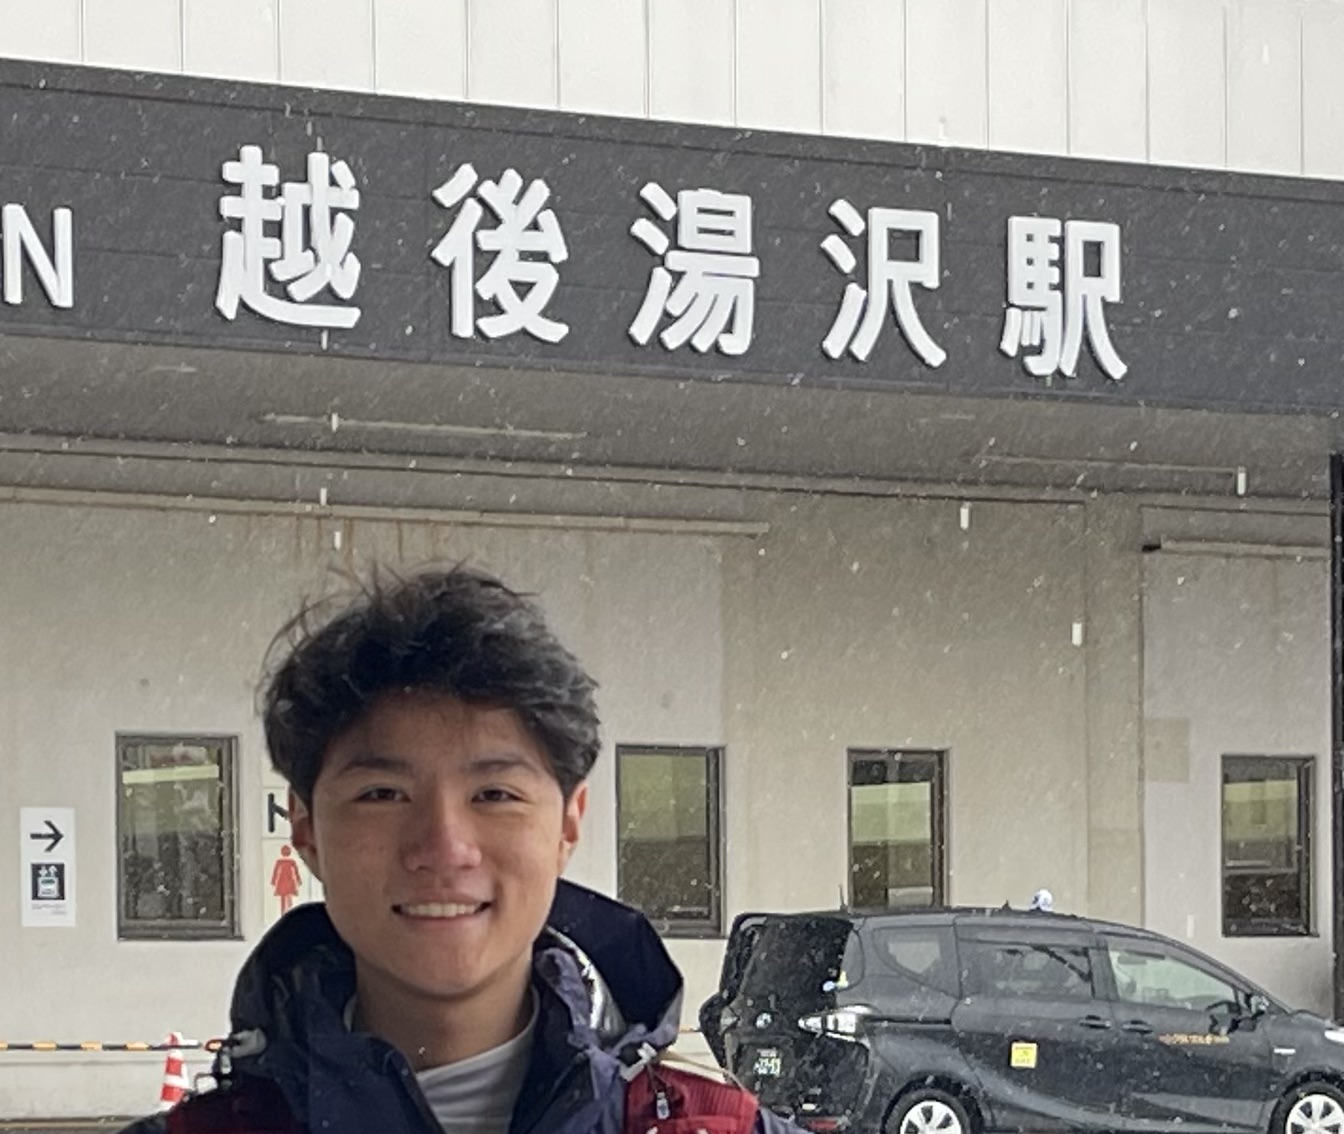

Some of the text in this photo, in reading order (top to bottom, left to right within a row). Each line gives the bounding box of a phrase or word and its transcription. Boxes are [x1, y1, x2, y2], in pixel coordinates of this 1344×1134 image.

[216, 145, 1129, 381] 越後湯沢駅
